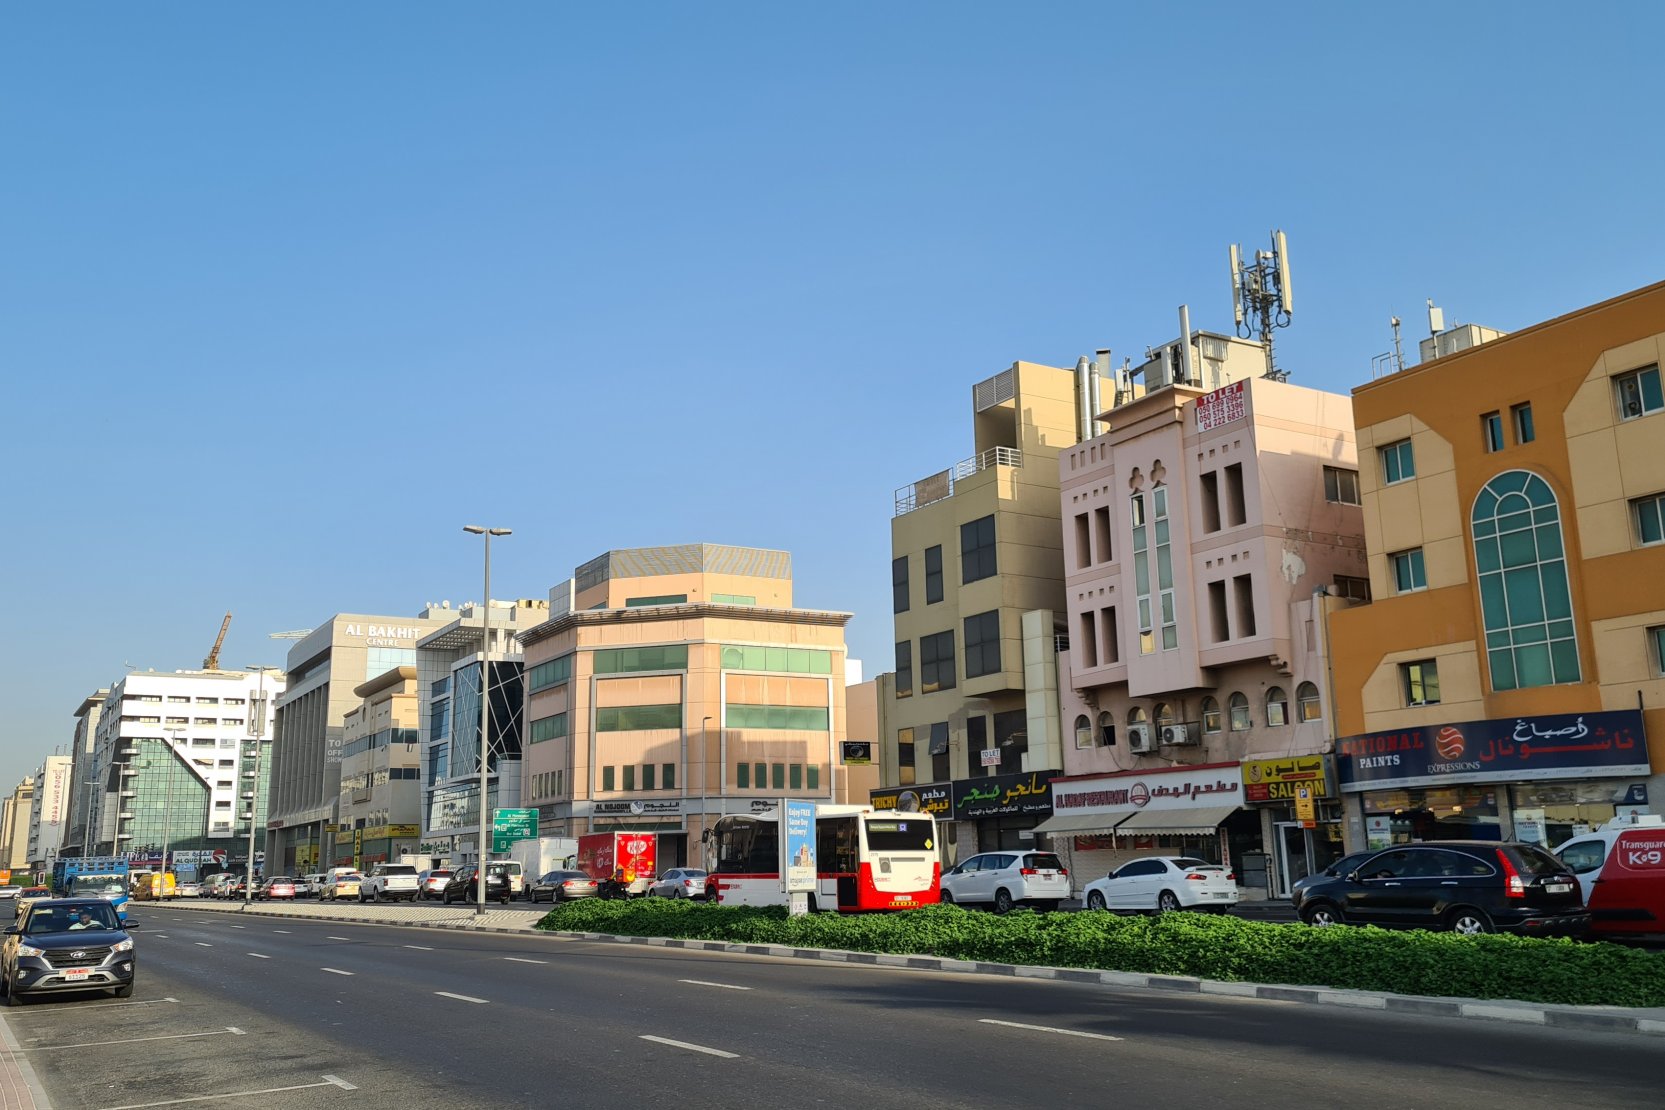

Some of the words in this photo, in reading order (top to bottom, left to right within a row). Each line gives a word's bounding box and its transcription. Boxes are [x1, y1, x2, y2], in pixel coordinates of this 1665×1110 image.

[1202, 392, 1216, 404] TO
[1219, 384, 1238, 399] LET
[1199, 405, 1210, 415] 050
[1199, 413, 1211, 423] 050
[1203, 420, 1212, 430] 04
[1214, 416, 1226, 426] 222
[345, 624, 364, 636] AL
[368, 625, 421, 639] BAKHIT
[366, 638, 399, 647] CENTRE
[1513, 716, 1588, 742] أصباغ
[328, 739, 341, 748] TO
[1342, 732, 1424, 757] NATIONAL
[1359, 755, 1400, 769] PAINTS
[1427, 761, 1480, 774] EXPRESSIONS
[921, 789, 946, 801] مطعم
[1002, 773, 1047, 804] مانجو
[1151, 783, 1191, 798] الهدف
[1191, 781, 1238, 800] مطعم
[872, 796, 897, 809] TRICHY
[957, 784, 1001, 808] جنجر
[788, 808, 800, 817] Enjoy
[800, 808, 811, 817] FREE
